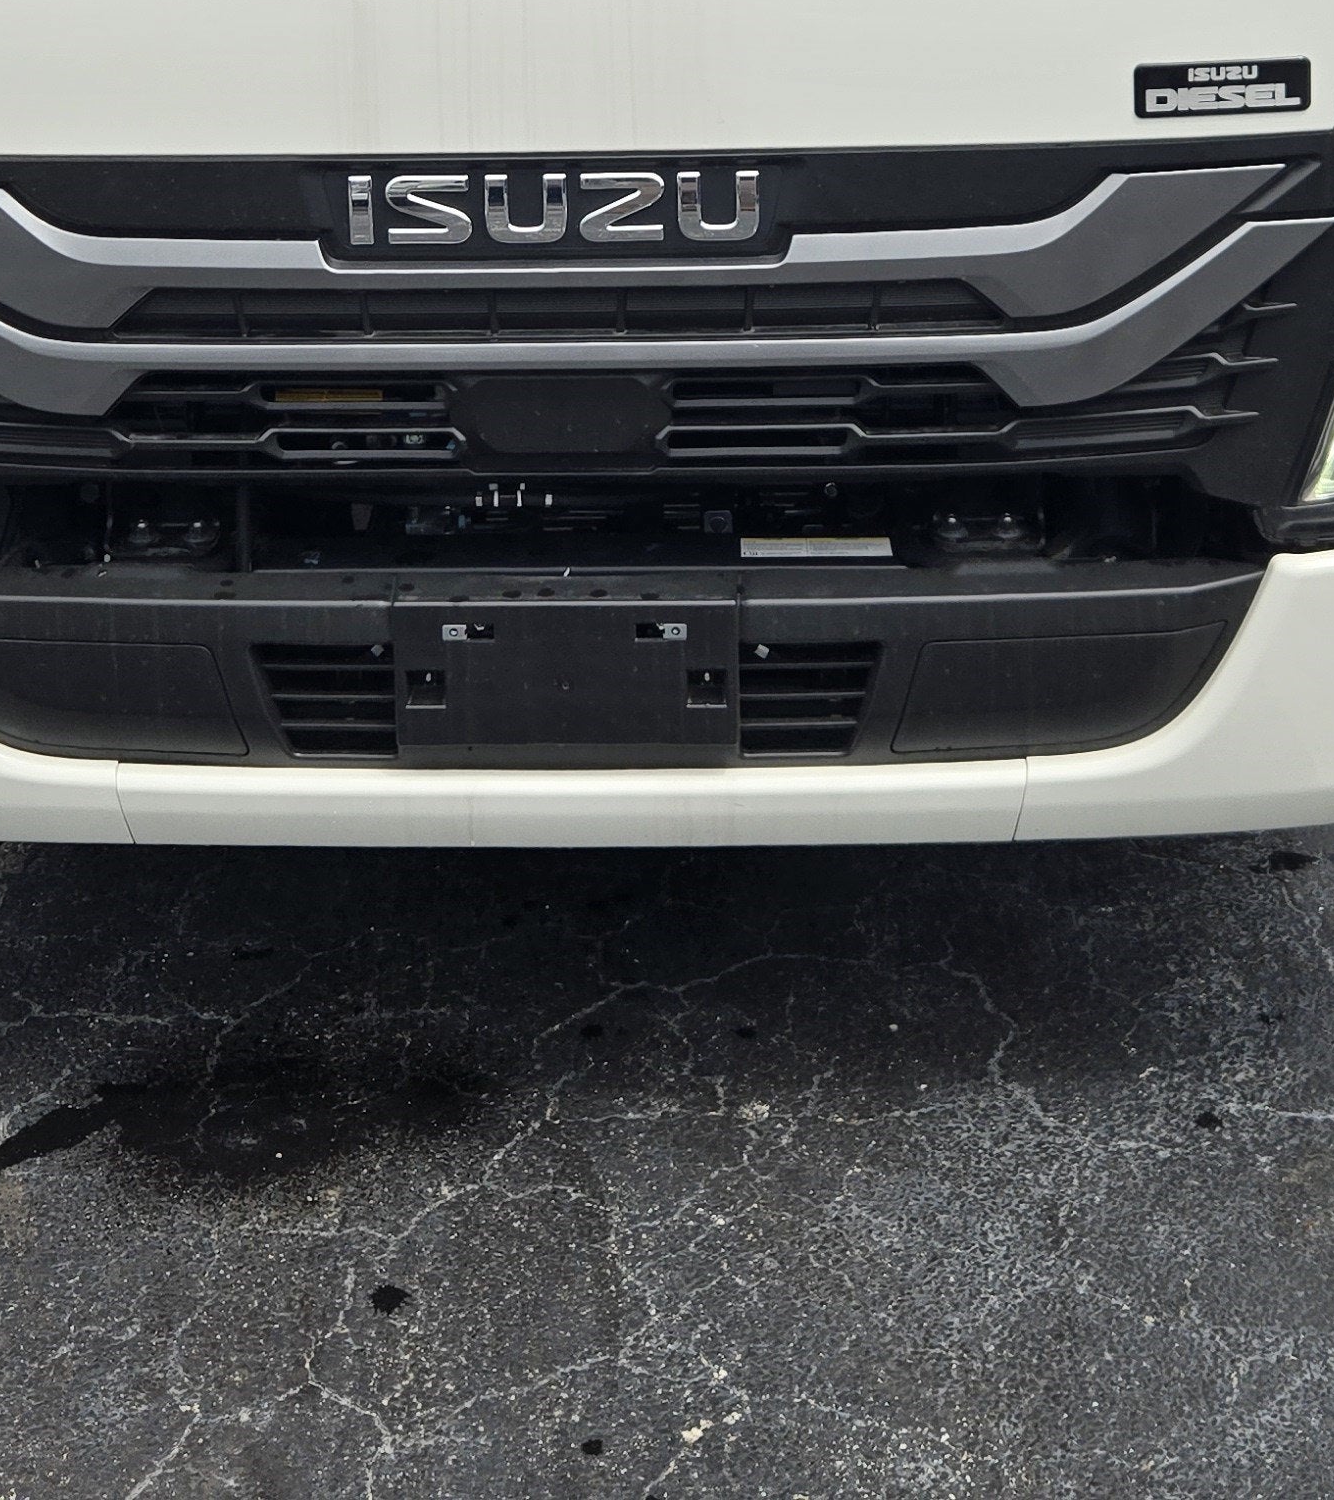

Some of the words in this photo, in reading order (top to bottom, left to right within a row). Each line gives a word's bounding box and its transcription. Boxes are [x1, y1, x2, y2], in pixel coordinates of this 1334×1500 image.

[1187, 64, 1259, 82] ISUZU
[1144, 82, 1302, 113] DIESEL
[347, 170, 761, 245] ISUZU
